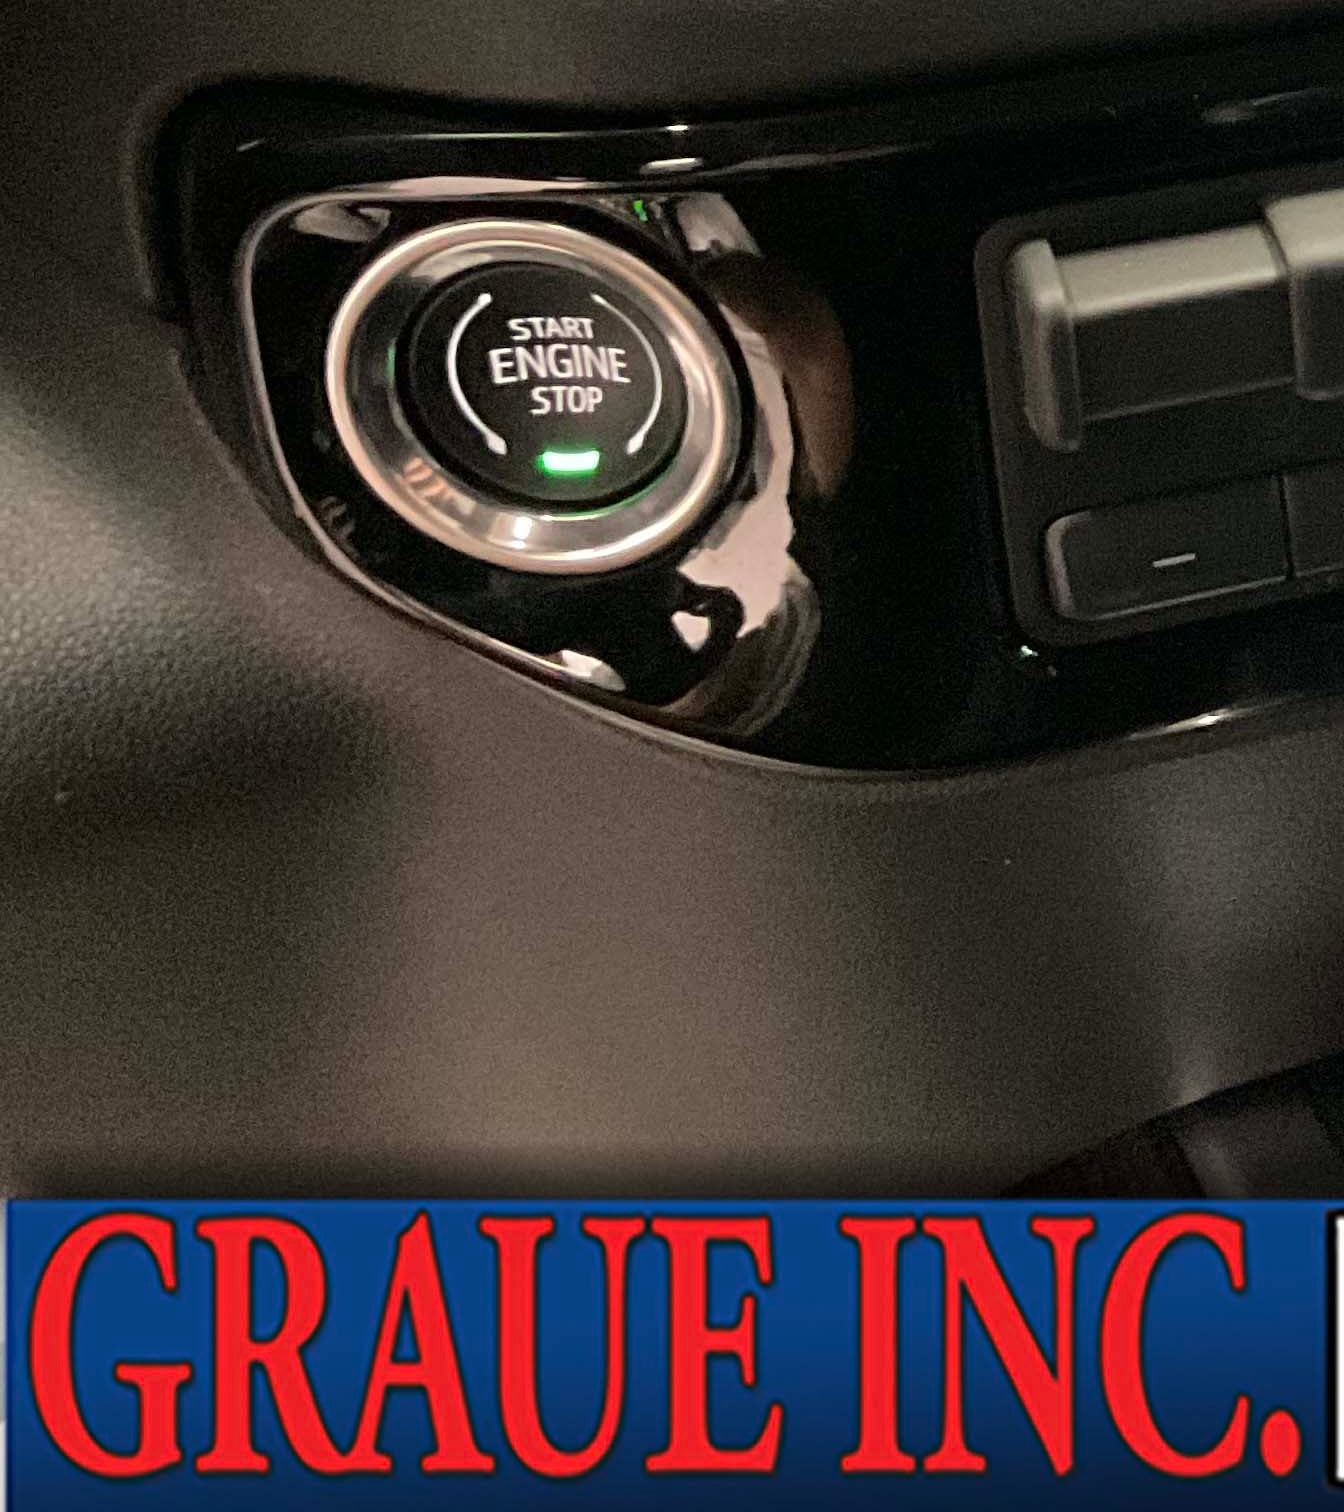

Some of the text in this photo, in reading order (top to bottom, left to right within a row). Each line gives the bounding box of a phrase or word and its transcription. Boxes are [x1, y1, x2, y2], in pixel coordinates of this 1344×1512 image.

[507, 316, 595, 341] START
[488, 343, 632, 384] ENGINE
[529, 385, 604, 416] STOP
